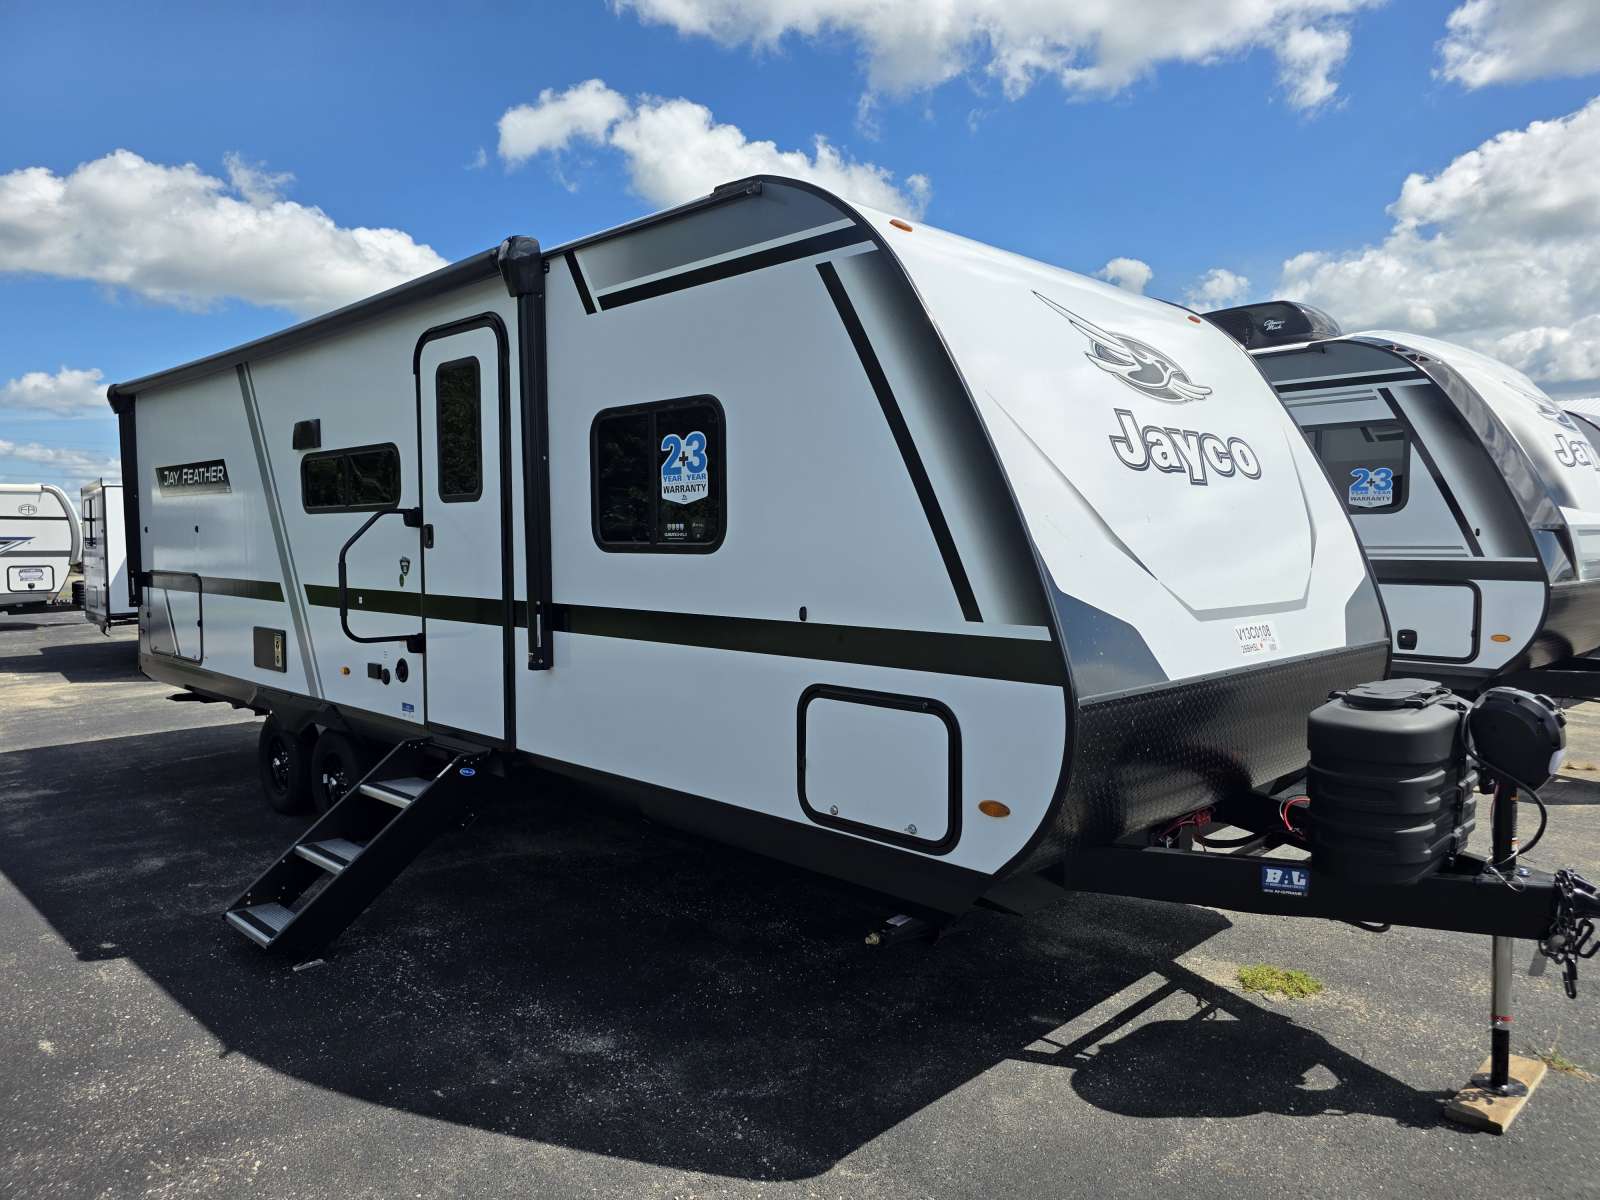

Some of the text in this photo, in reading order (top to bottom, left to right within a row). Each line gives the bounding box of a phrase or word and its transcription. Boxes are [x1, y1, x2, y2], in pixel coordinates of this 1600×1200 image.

[1108, 407, 1262, 486] Jayco
[164, 466, 225, 486] JAY FEATHER
[663, 483, 706, 494] WARRANTY
